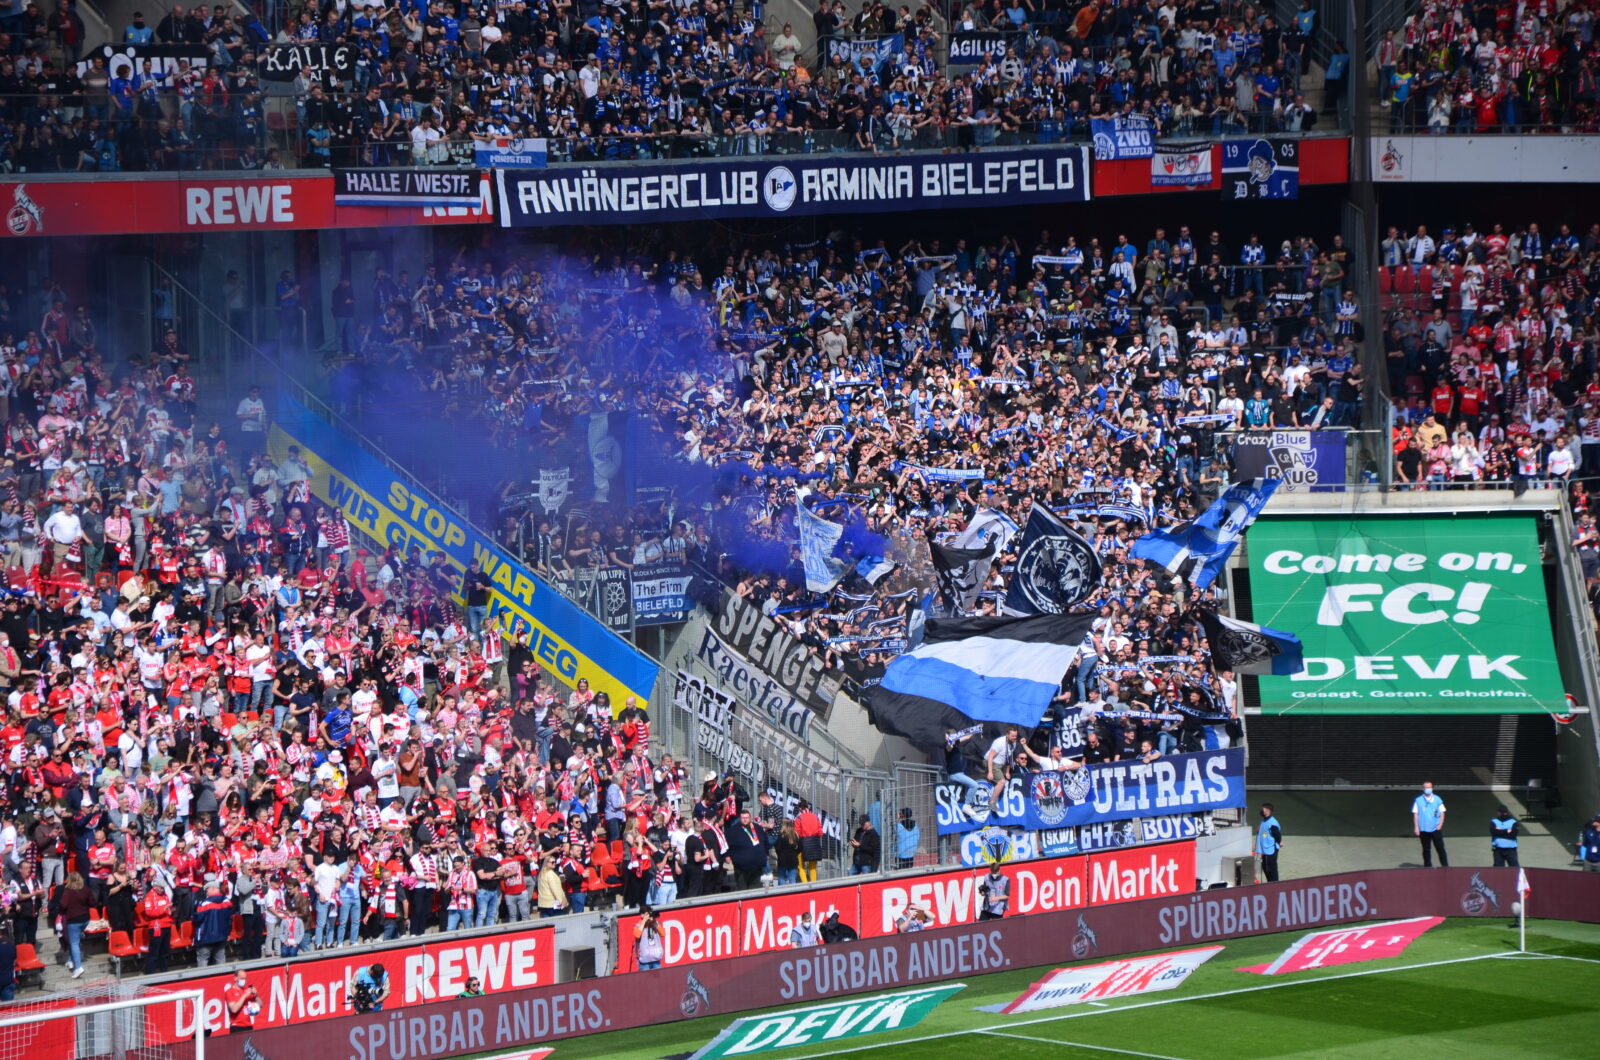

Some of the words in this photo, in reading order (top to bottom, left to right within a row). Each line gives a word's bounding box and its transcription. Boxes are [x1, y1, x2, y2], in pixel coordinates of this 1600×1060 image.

[266, 46, 349, 71] KALLE
[1115, 130, 1151, 147] ZWO
[346, 173, 400, 192] HALLE
[414, 174, 471, 193] WESTF.
[517, 169, 758, 214] ANHÄNGERCLUB
[802, 165, 913, 202] ARMINIA
[922, 158, 1075, 196] BIELEFELD
[186, 185, 294, 225] REWE
[1237, 434, 1273, 448] Crazy
[1276, 433, 1307, 445] Blue
[388, 481, 466, 548] STOP
[473, 541, 536, 607] WAR
[1263, 550, 1427, 575] Come
[1438, 552, 1528, 574] on,
[328, 474, 380, 531] WIR
[488, 597, 578, 681] KRIEG
[636, 584, 656, 596] The
[659, 581, 682, 593] Firm
[1316, 582, 1493, 626] FC!
[720, 592, 825, 701] SPENGE
[1290, 655, 1528, 681] DEVK
[675, 671, 736, 730] PORTA
[698, 626, 812, 740] Raesfeld
[1291, 689, 1363, 699] Gesagt.
[1370, 689, 1432, 698] Getan.
[1439, 689, 1533, 698] Geholfen.
[739, 709, 853, 794] FETTKATZEN
[936, 784, 968, 825] SK
[1091, 755, 1230, 813] ULTRAS
[1081, 821, 1115, 849] 647
[1142, 815, 1195, 840] BOYS
[662, 915, 732, 964] Dein
[743, 901, 840, 951] Makt
[1016, 867, 1081, 912] Dein
[1092, 855, 1179, 902] Markt
[1159, 895, 1267, 943] SPÜRBAR
[1276, 882, 1377, 927] ANDERS.
[268, 966, 352, 1021] Mar
[405, 939, 538, 1002] REWE
[780, 947, 899, 1000] SPÜRBAR
[908, 931, 1011, 981] ANDERS.
[349, 1008, 486, 1060] SPÜRBAR
[495, 990, 611, 1044] ANDERS.
[722, 993, 938, 1055] DEVK
